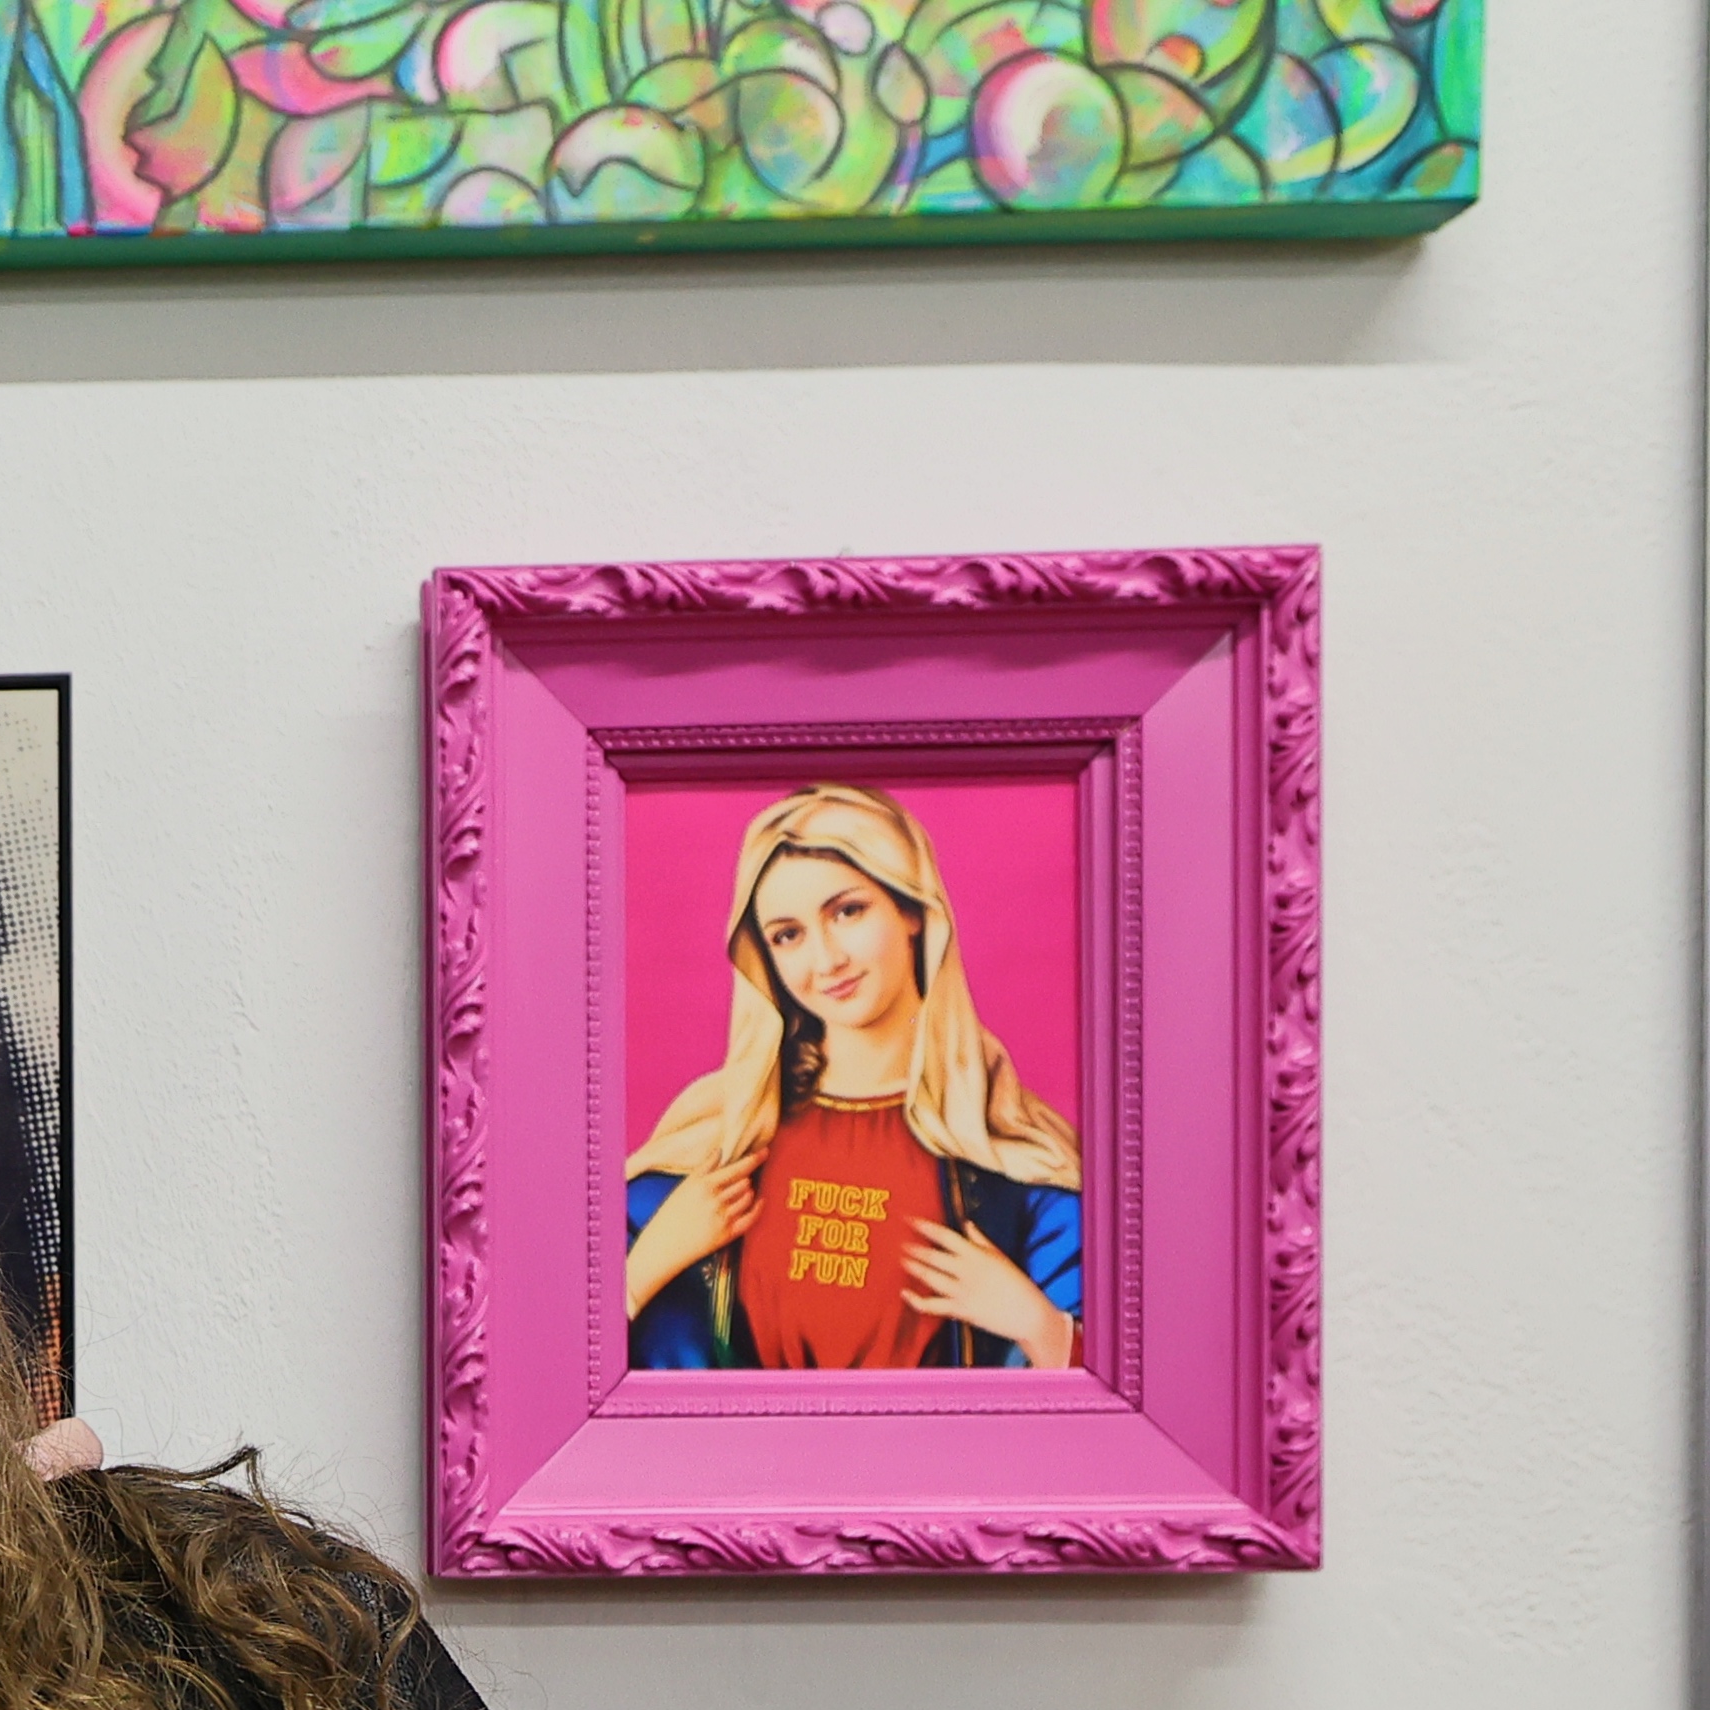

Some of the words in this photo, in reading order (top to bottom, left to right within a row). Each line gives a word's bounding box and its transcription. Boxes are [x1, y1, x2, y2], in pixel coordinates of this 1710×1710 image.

[788, 1178, 890, 1221] FUCK
[796, 1215, 871, 1253] FOR
[788, 1249, 869, 1288] FUN
